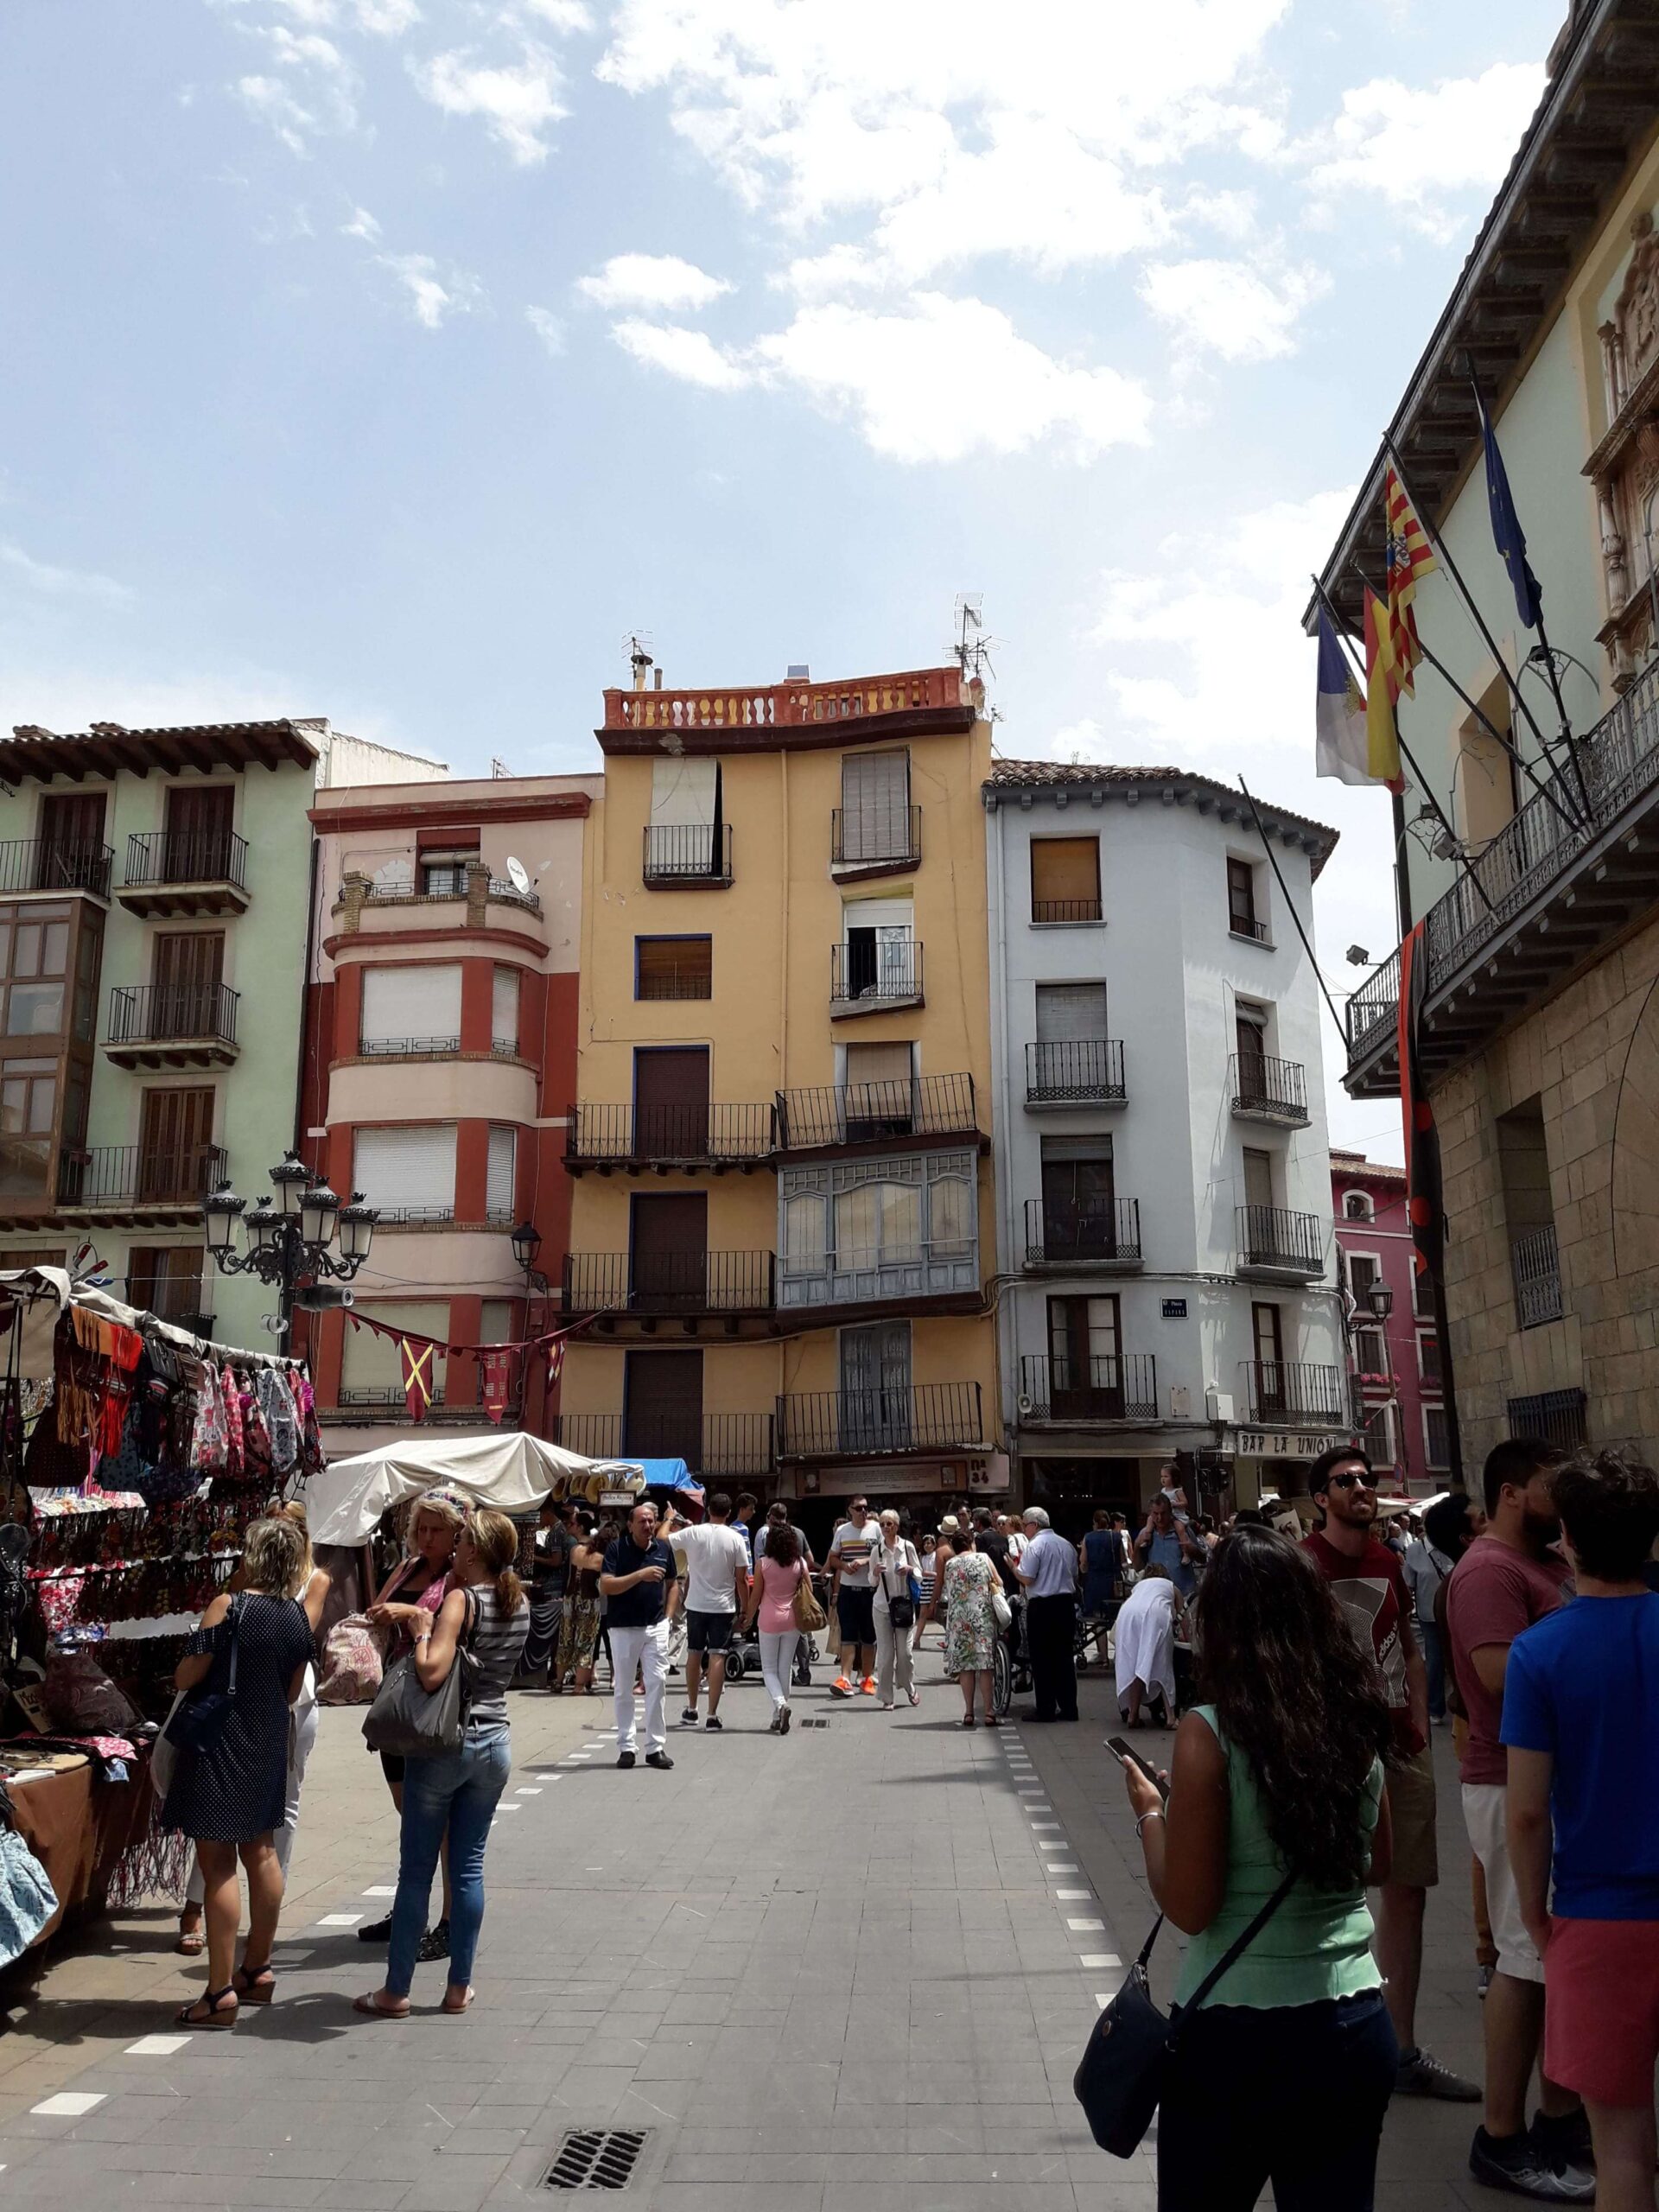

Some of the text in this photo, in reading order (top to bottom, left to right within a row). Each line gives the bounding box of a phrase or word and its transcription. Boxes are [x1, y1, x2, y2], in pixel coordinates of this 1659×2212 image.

[1242, 1434, 1264, 1452] BAR
[1274, 1436, 1288, 1453] LA
[971, 1471, 989, 1484] 34
[1378, 1630, 1396, 1662] adidas
